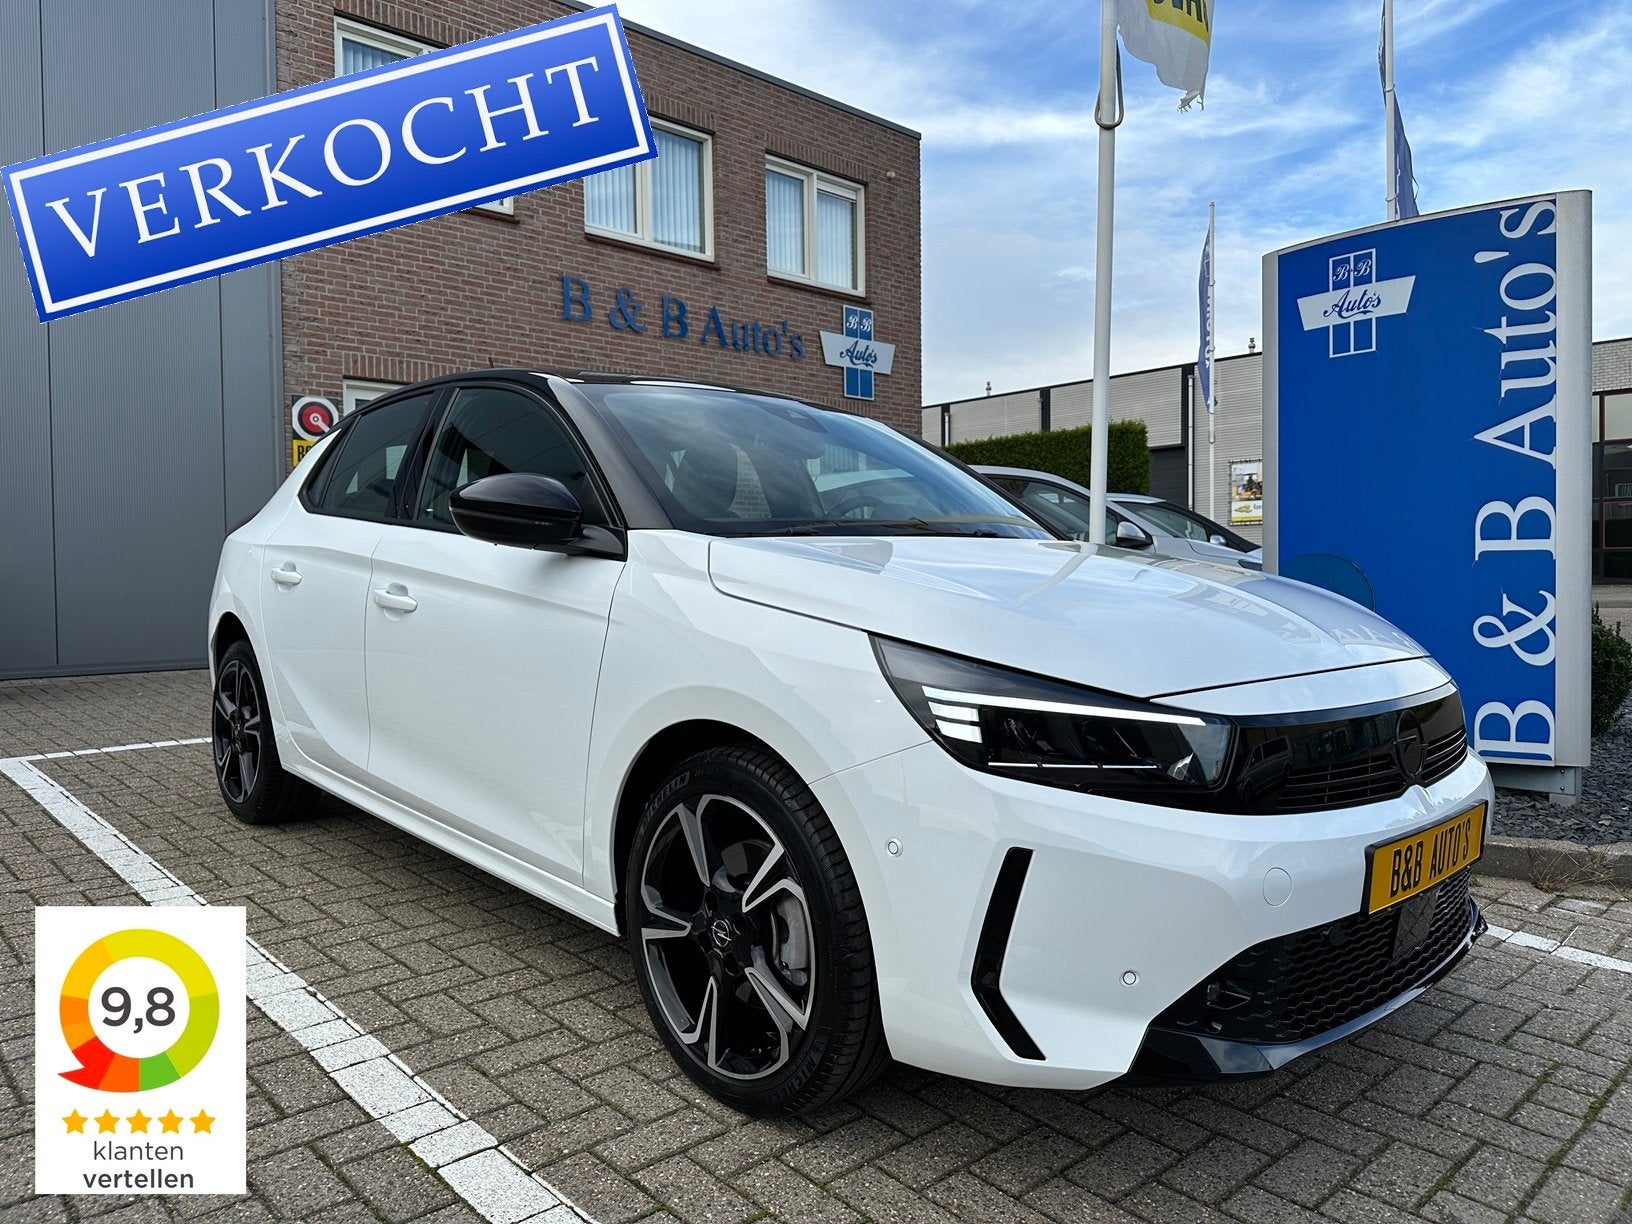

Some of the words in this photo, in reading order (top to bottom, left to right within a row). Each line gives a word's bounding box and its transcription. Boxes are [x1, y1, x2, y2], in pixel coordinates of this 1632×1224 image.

[562, 274, 593, 322] B
[608, 287, 646, 333] &
[662, 296, 689, 339] B
[701, 306, 805, 361] Auto's
[1323, 289, 1381, 319] Auto's
[1474, 201, 1556, 470] Auto's
[840, 340, 877, 368] Auto's
[1475, 496, 1556, 561] B
[1473, 590, 1556, 666] &
[1474, 700, 1555, 761] B
[1390, 840, 1424, 898] B&B
[1428, 817, 1471, 880] AUTO'S
